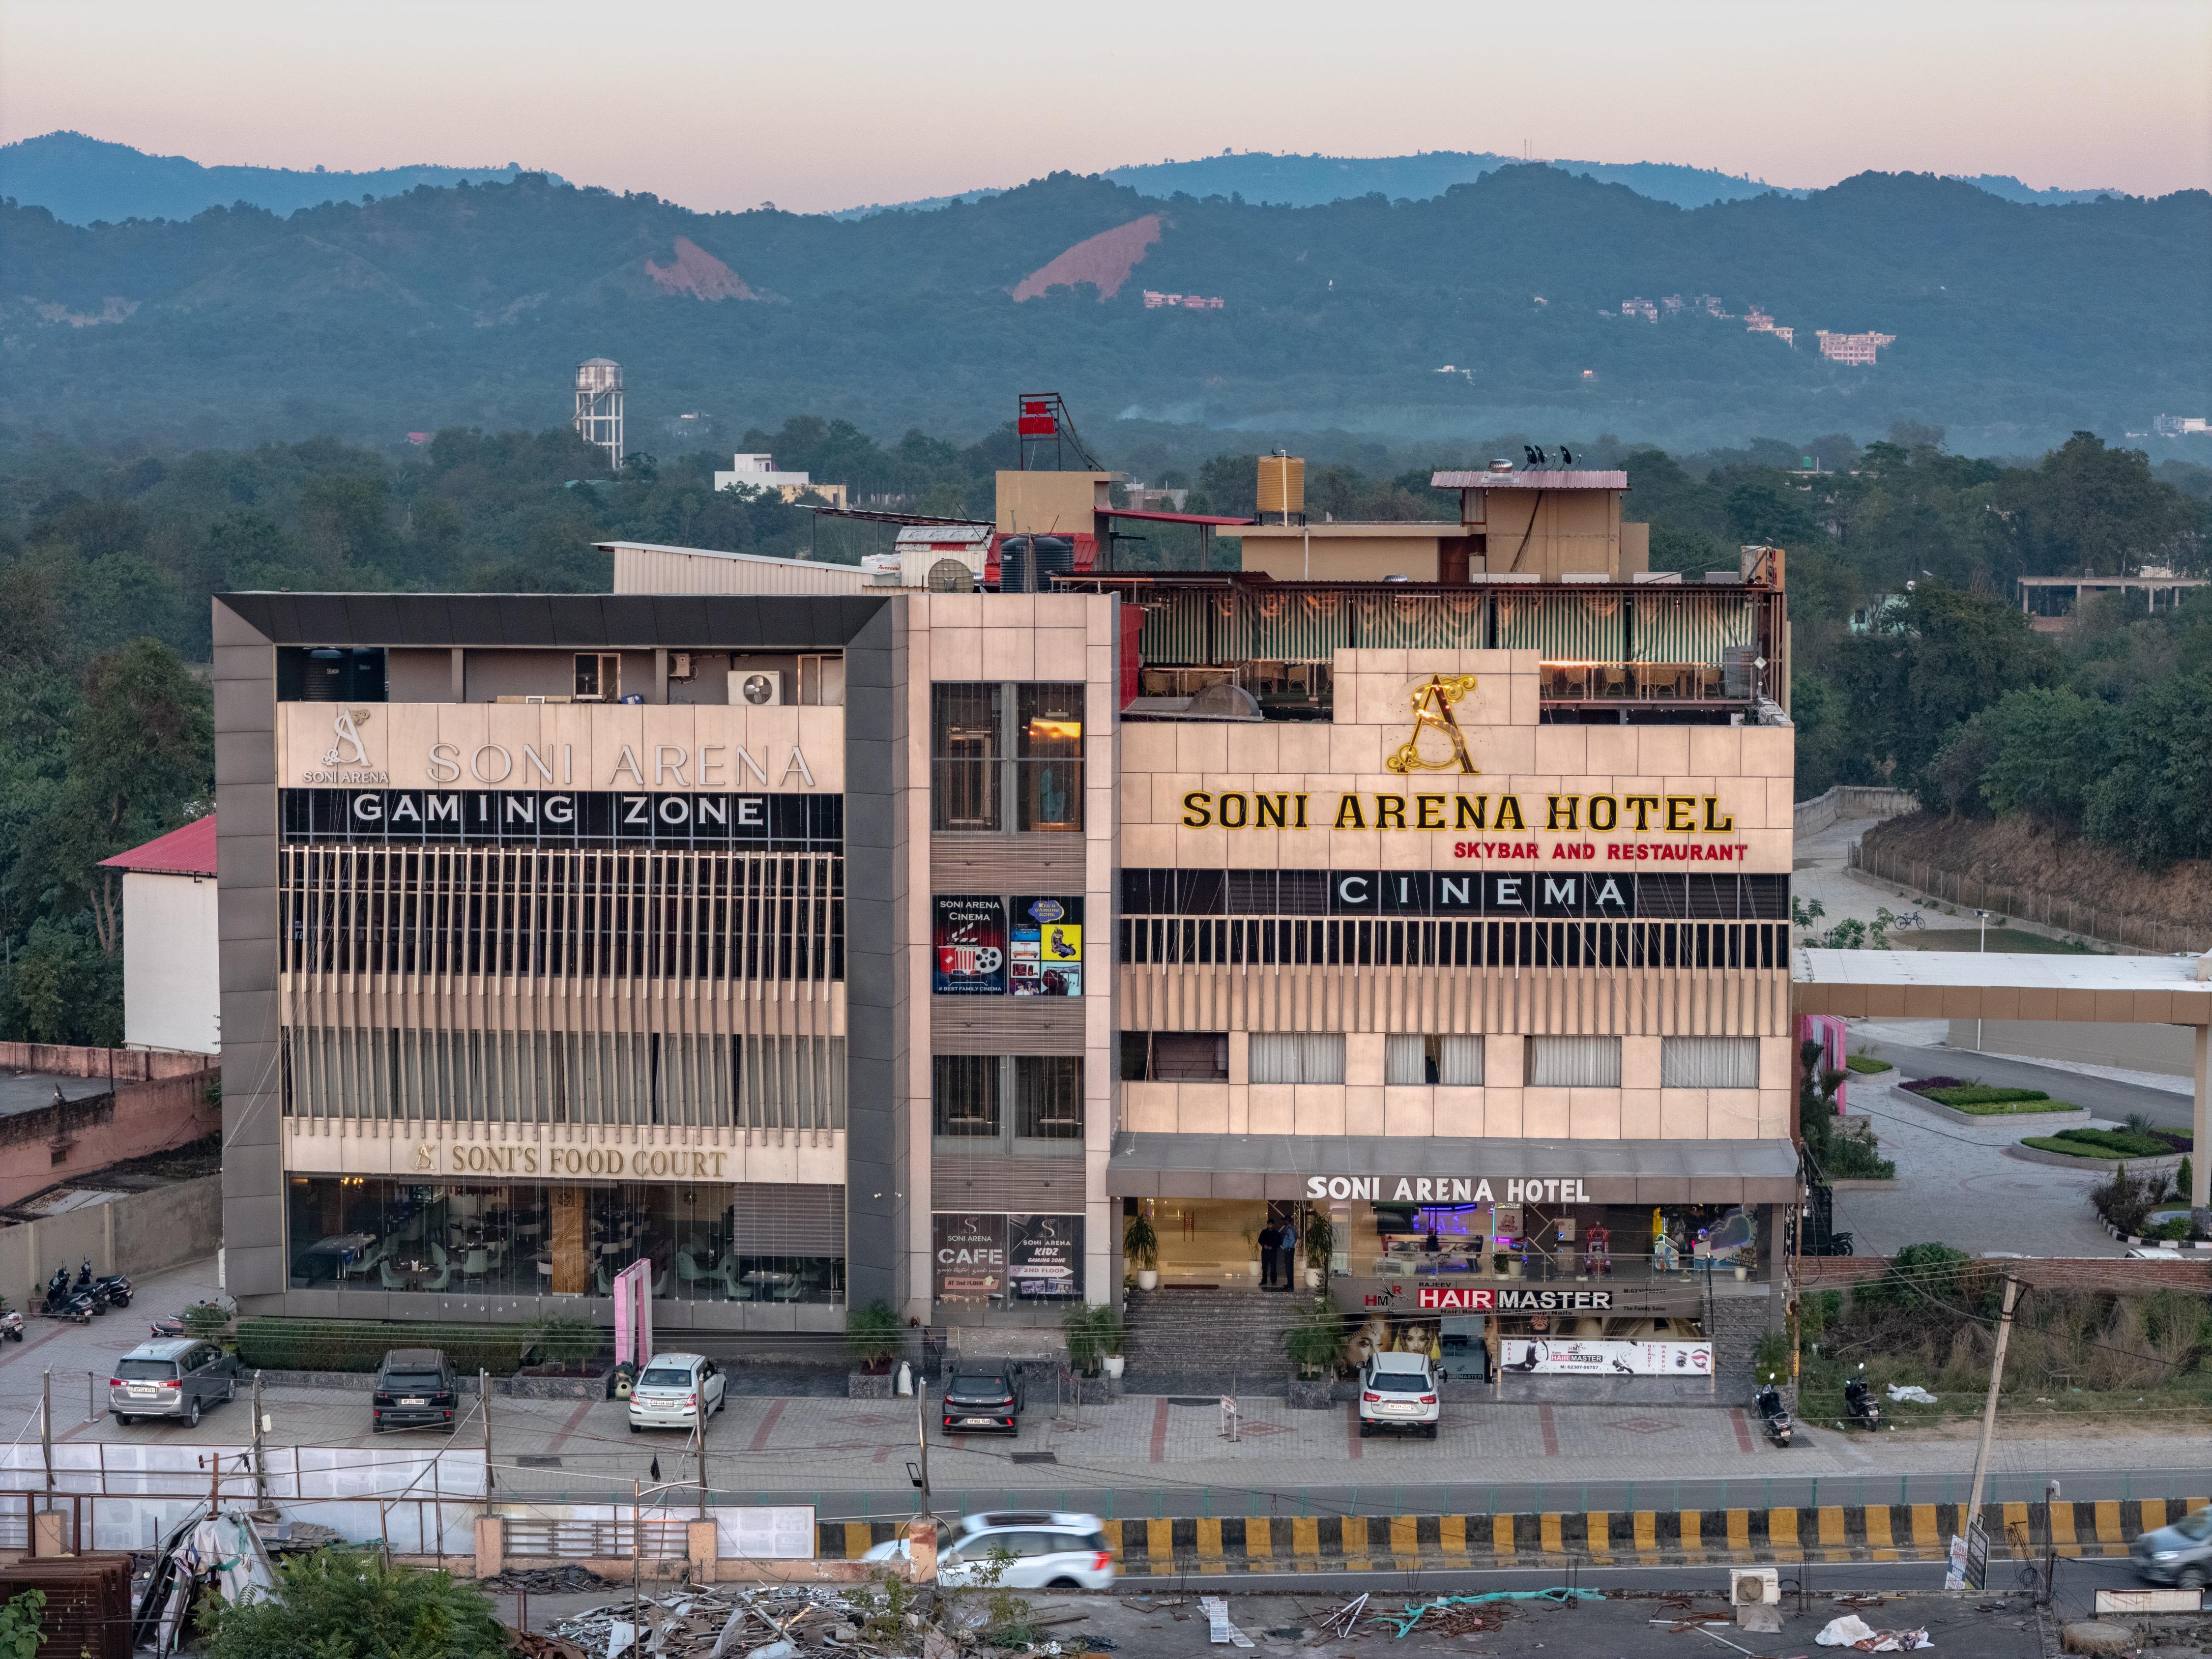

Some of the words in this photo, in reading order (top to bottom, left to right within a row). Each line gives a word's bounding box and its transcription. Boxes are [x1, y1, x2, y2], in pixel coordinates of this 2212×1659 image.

[427, 743, 571, 784] SONI
[610, 745, 815, 786] ARENA
[303, 771, 338, 783] SONI
[341, 771, 389, 784] ARENA
[353, 793, 574, 823] GAMING
[623, 796, 763, 825] ZONE
[1182, 790, 1309, 830] SONI
[1334, 792, 1527, 831] ARENA
[1545, 794, 1734, 833] HOTEL
[1455, 842, 1539, 859] SKYBAR
[1552, 844, 1596, 860] AND
[1607, 844, 1748, 861] RESTAURANT
[1339, 876, 1626, 905] CINEMA
[452, 1145, 537, 1173] SONI'S
[549, 1148, 625, 1174] FOOD
[632, 1150, 728, 1177] COURT
[1307, 1177, 1380, 1200] SONI
[1393, 1178, 1494, 1201] ARENA
[1507, 1179, 1590, 1202] HOTEL
[938, 1249, 1003, 1264] CAFE
[1034, 1248, 1059, 1256] KIDZ
[1420, 1290, 1493, 1308] HAIR
[1499, 1291, 1611, 1309] MASTER
